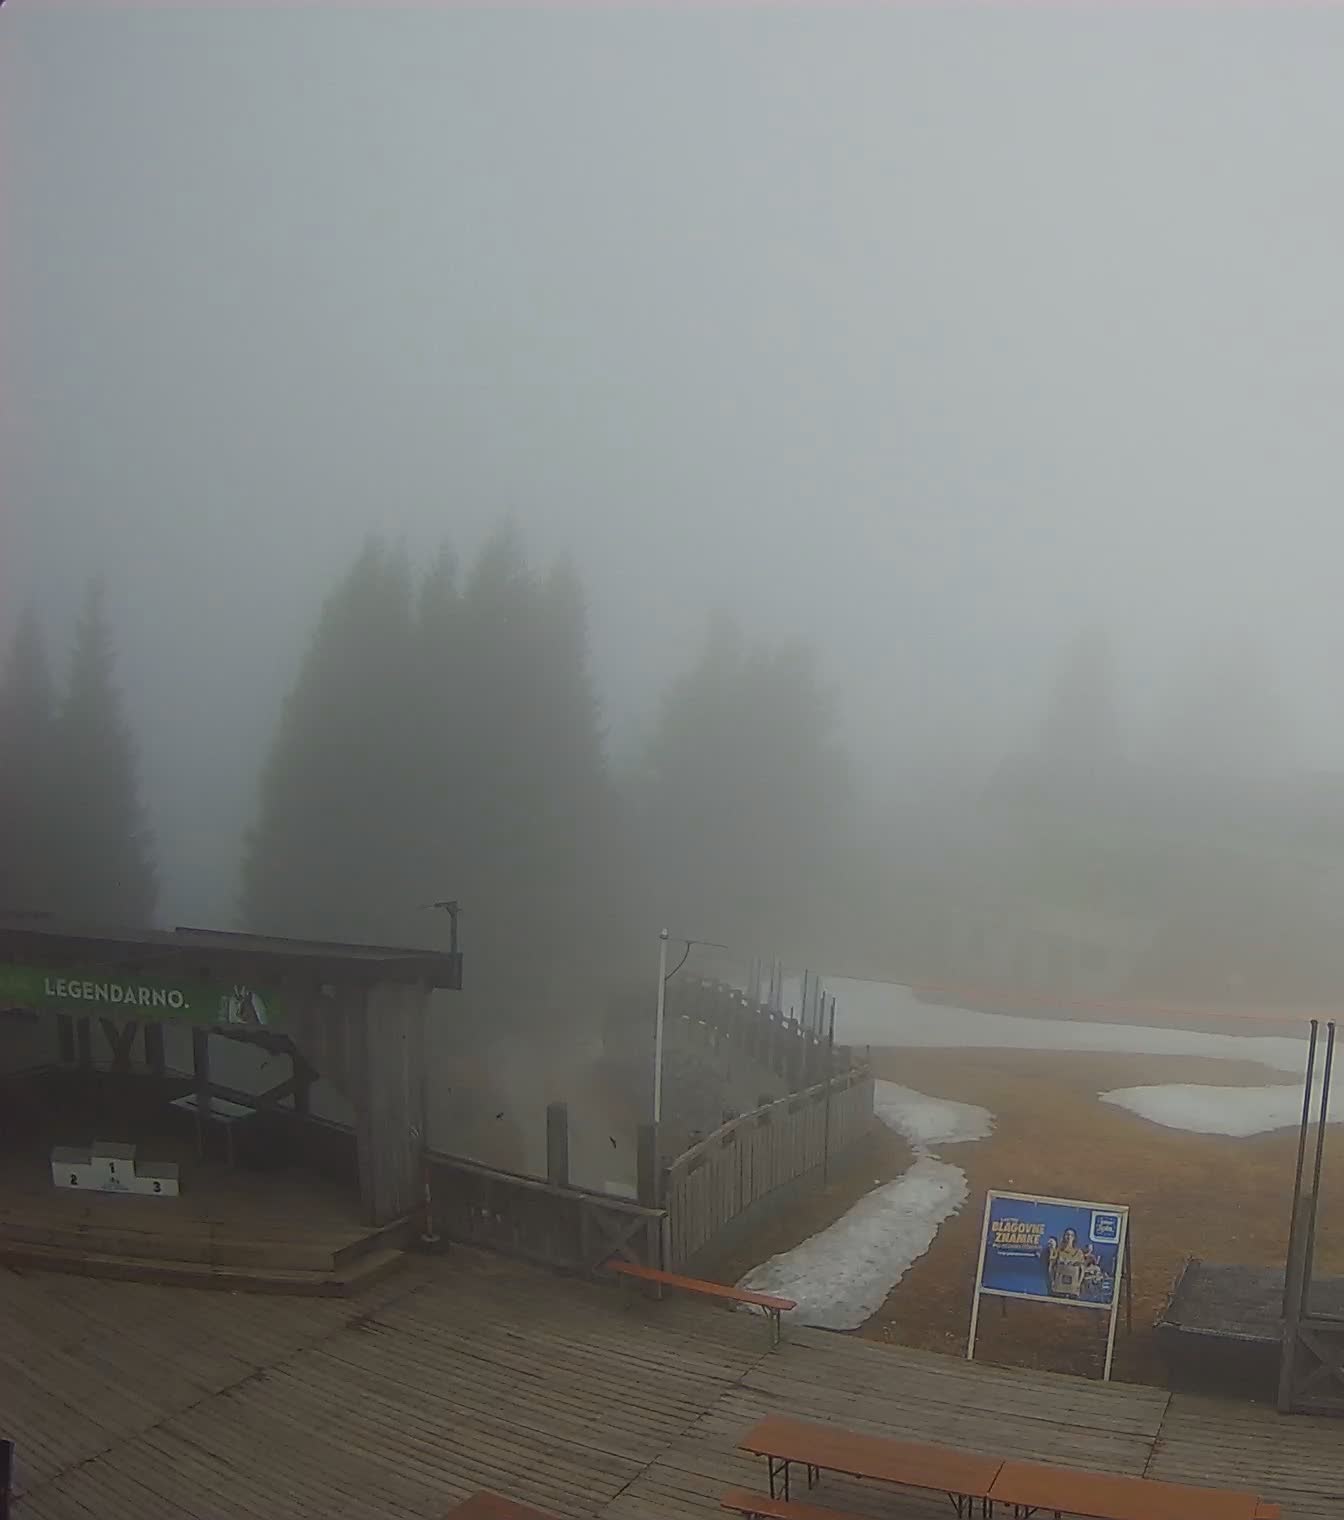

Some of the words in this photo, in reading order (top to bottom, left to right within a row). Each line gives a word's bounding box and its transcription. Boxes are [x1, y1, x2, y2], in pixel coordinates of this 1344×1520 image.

[44, 978, 190, 1009] LEGENDARNO.
[109, 1161, 116, 1174] 1
[70, 1173, 78, 1186] 2
[153, 1181, 162, 1193] 3
[991, 1221, 1046, 1235] BLAGOVNE
[994, 1232, 1041, 1245] ZNAMKE
